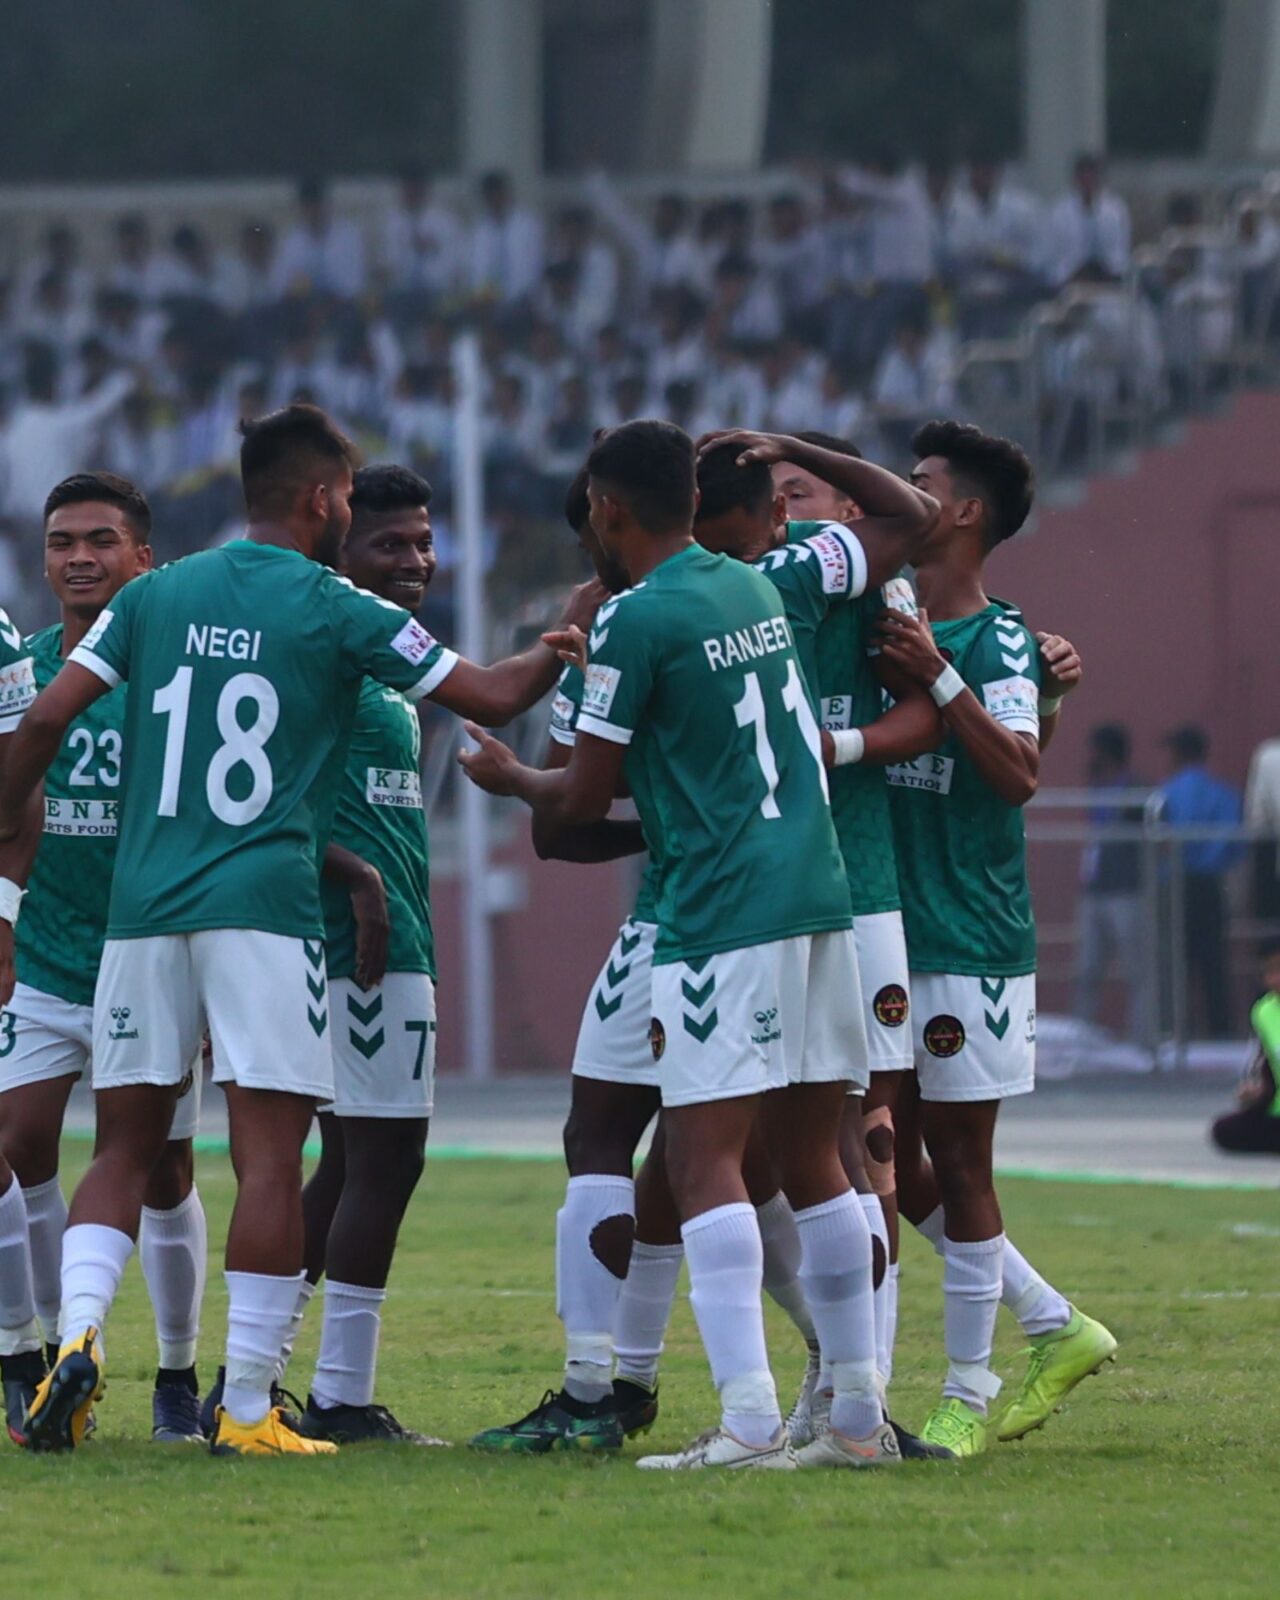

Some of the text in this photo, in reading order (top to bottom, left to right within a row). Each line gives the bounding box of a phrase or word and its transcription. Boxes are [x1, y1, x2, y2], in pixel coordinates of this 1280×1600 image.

[185, 623, 262, 662] NEGI
[703, 616, 793, 672] RANJEET
[67, 727, 123, 788] 23
[152, 666, 280, 826] 18
[733, 658, 830, 820] 11
